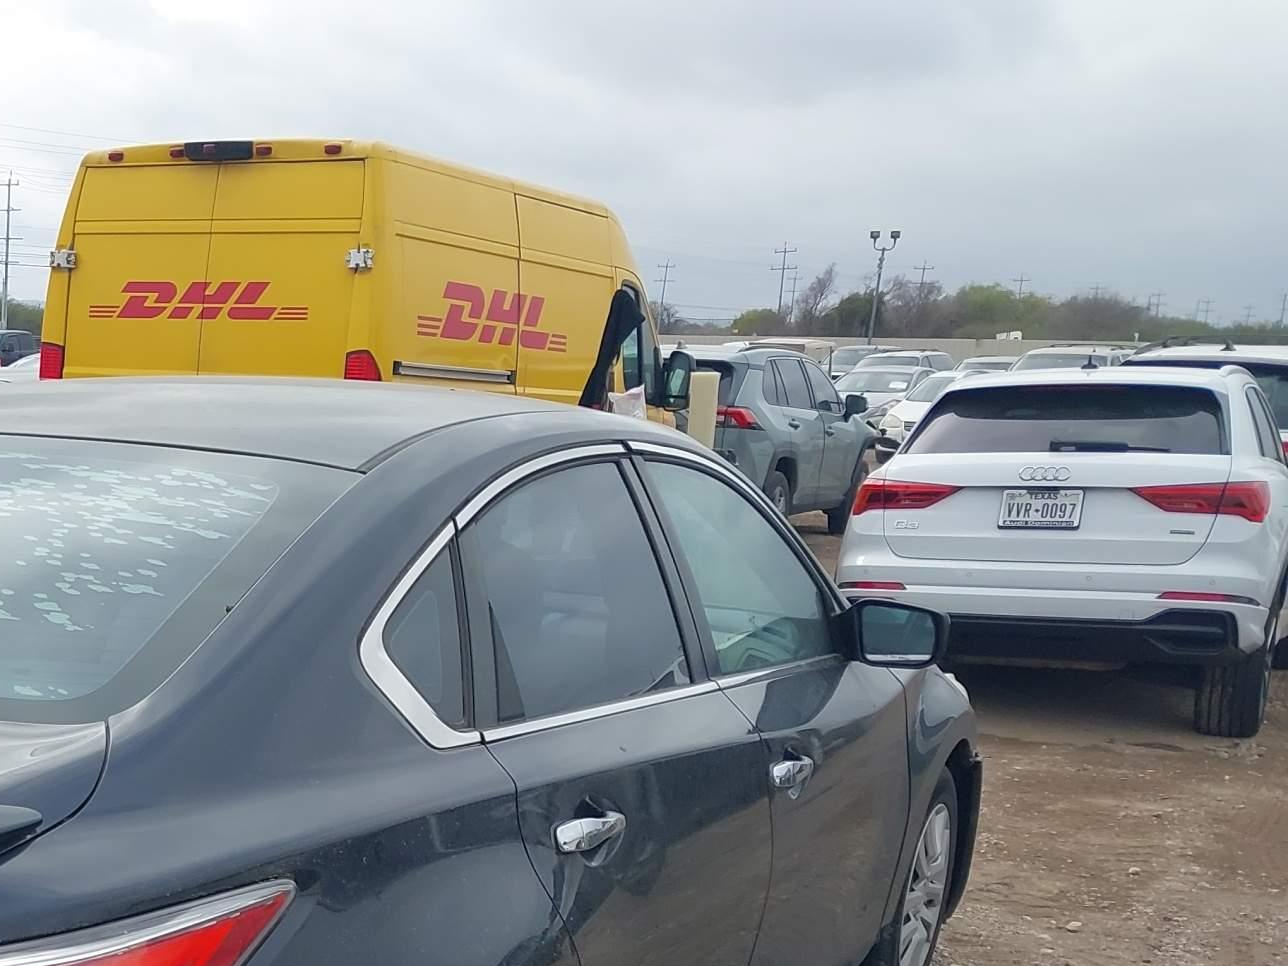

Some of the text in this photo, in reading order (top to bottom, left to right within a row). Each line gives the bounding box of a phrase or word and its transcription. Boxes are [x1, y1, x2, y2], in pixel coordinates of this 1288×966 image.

[119, 281, 276, 321] DHL
[439, 280, 550, 350] DHL
[1028, 492, 1059, 501] TEXAS
